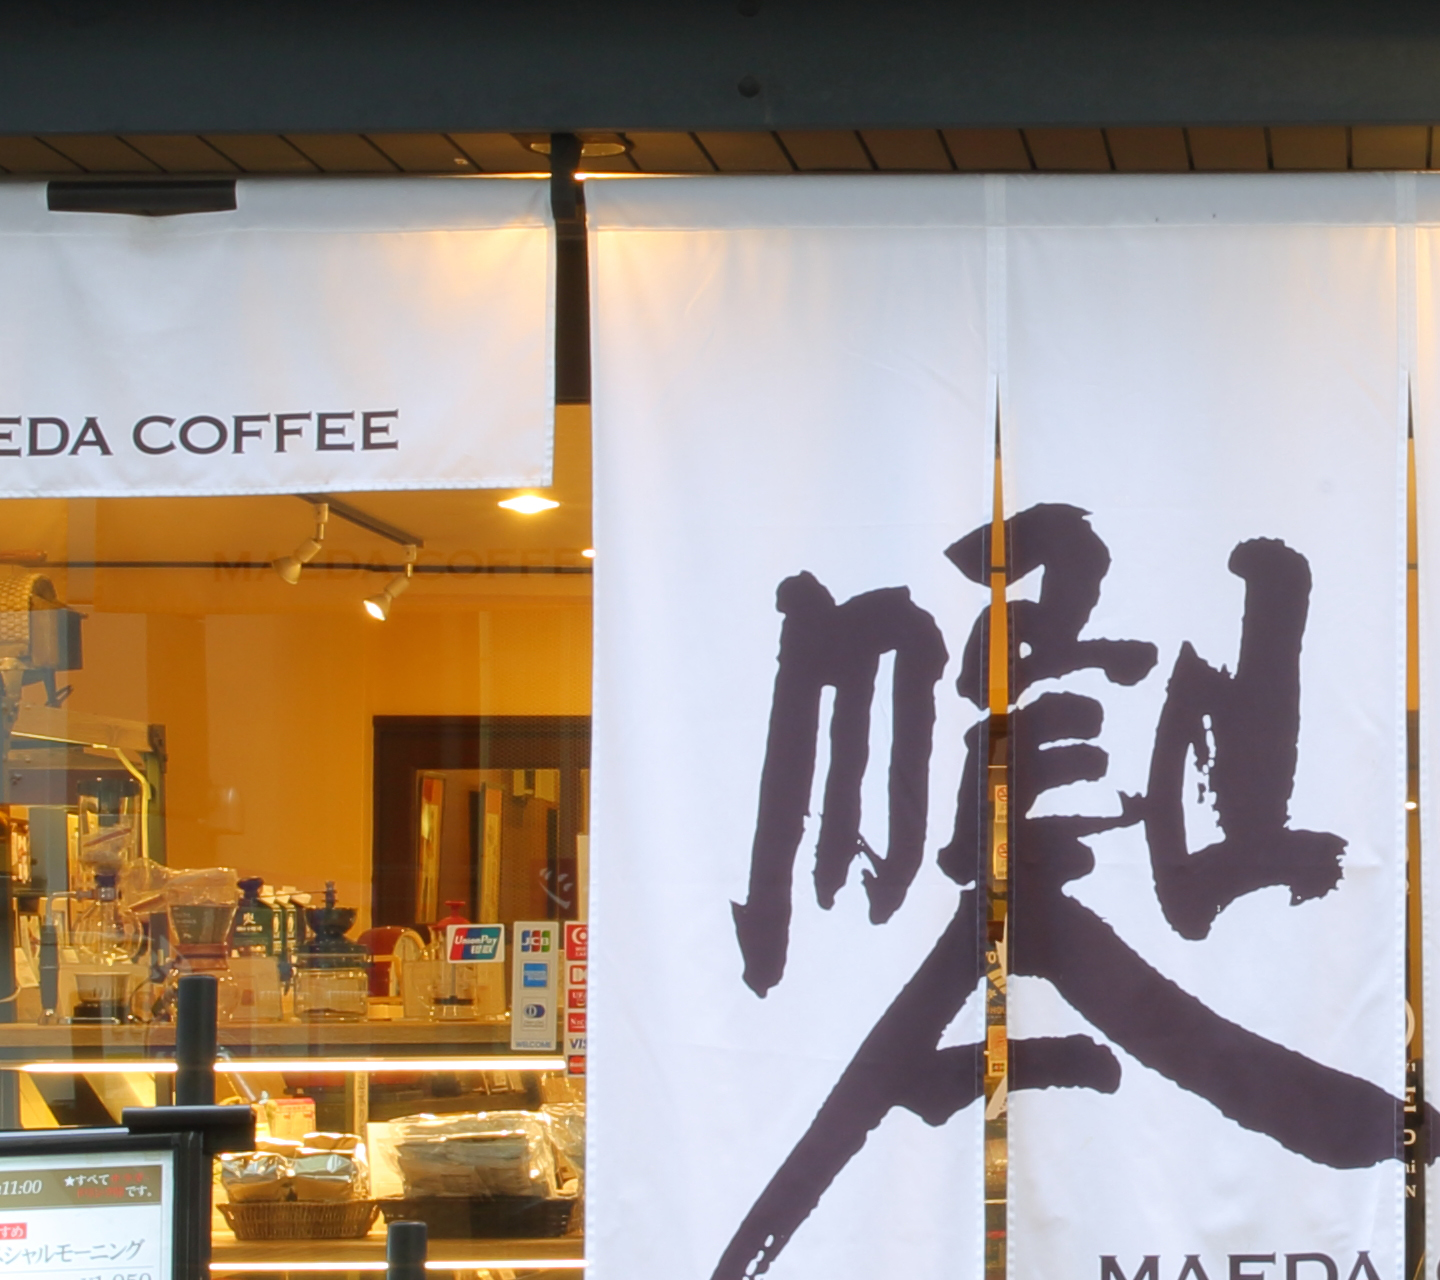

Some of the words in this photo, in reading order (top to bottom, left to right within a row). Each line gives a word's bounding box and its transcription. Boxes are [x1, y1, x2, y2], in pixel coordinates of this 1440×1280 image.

[132, 408, 400, 455] COFFEE
[455, 934, 498, 947] UnionPay
[515, 1041, 551, 1049] WELCOME
